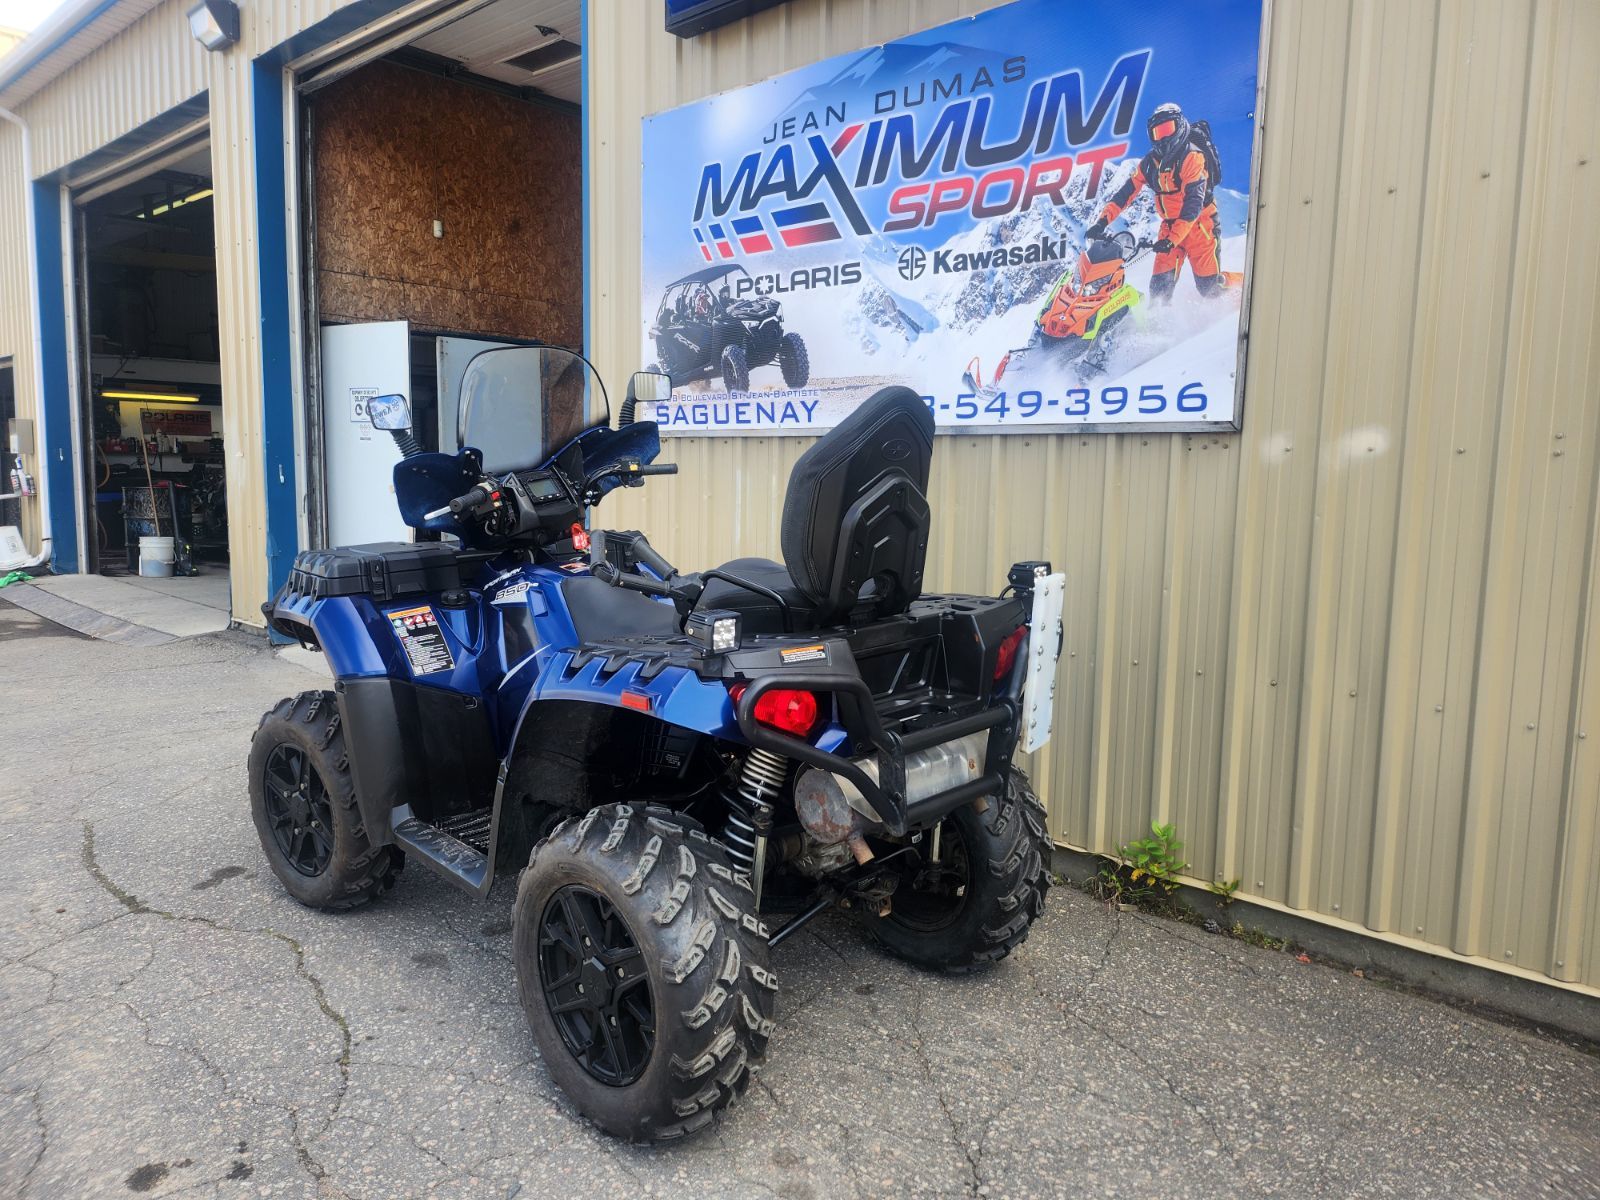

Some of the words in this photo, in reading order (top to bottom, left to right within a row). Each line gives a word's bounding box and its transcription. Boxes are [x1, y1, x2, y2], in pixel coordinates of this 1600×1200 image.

[763, 102, 847, 145] JEAN
[874, 56, 1027, 113] DUMAS
[692, 48, 1152, 236] MAXIMUM
[885, 143, 1129, 233] SPORT
[933, 236, 1067, 275] Kawasaki
[737, 262, 862, 299] POLARIS
[142, 412, 209, 423] POLARIS
[656, 400, 819, 425] SAGUENAY
